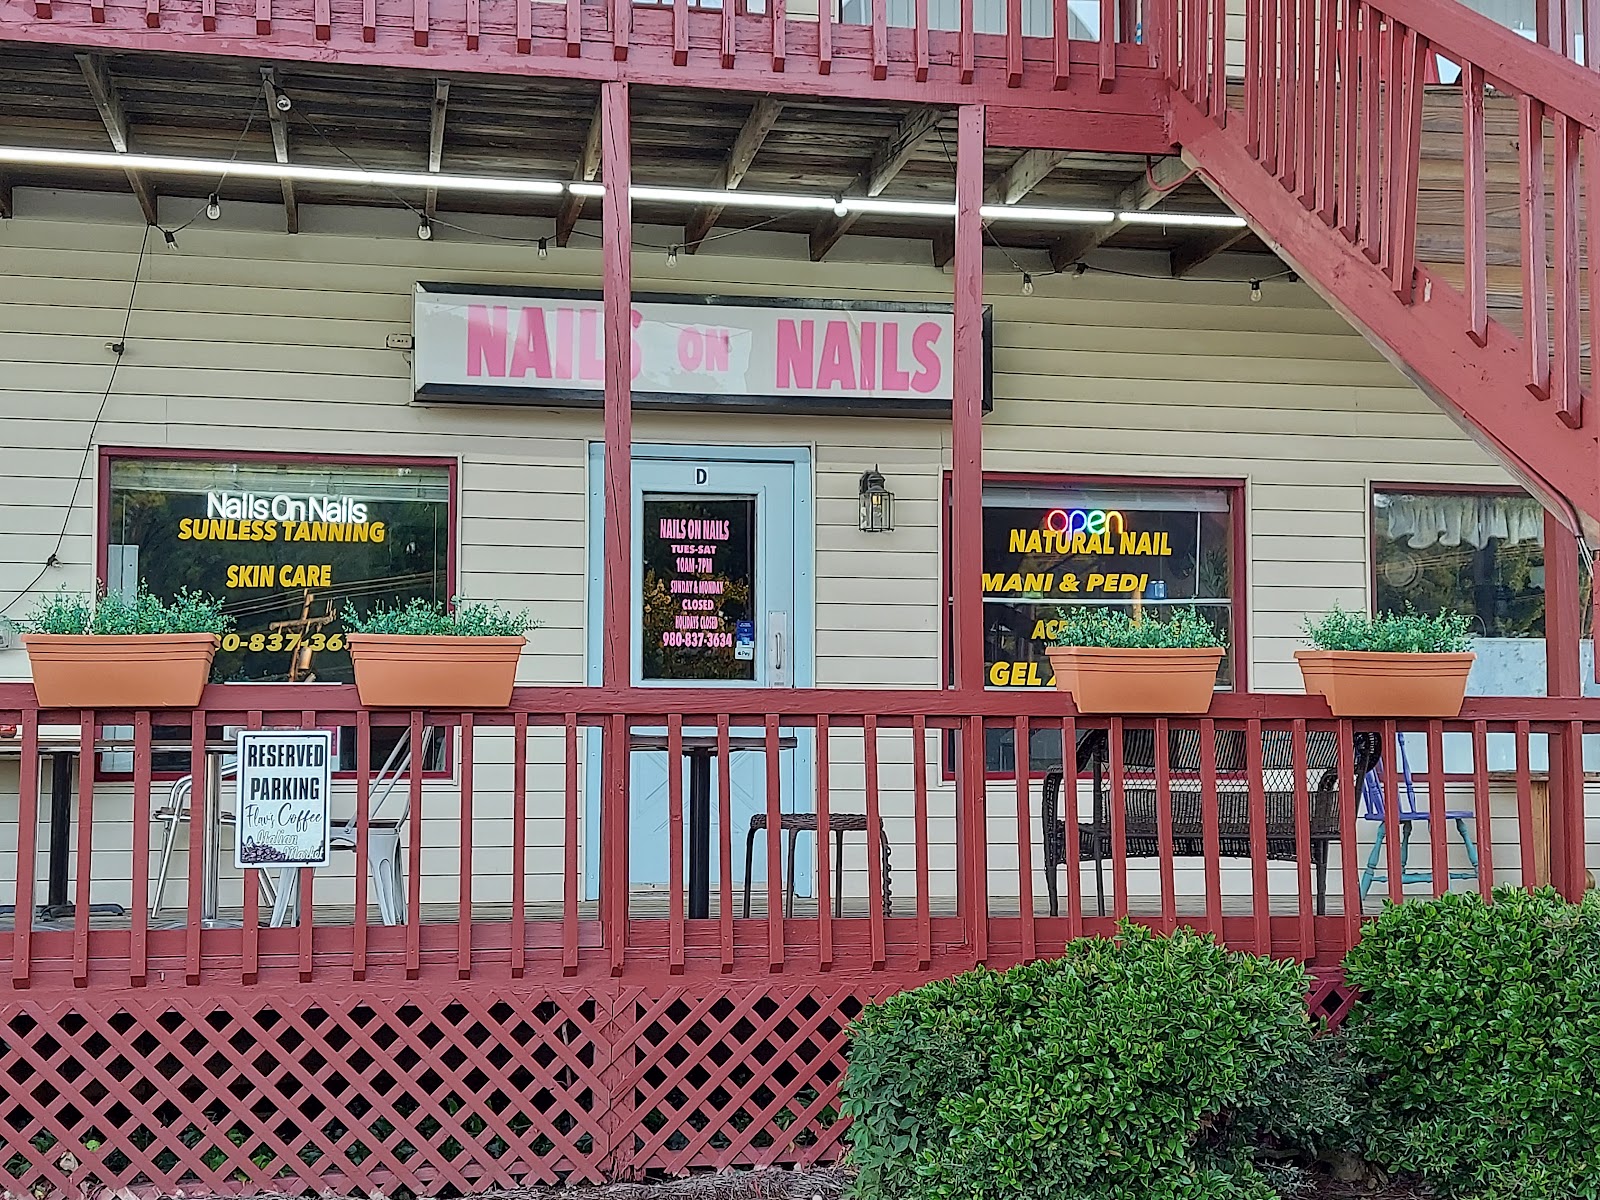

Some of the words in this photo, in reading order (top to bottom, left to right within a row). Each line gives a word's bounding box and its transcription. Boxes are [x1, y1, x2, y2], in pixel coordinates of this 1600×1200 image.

[678, 328, 728, 371] ON
[776, 319, 942, 393] NAILS
[696, 468, 707, 485] D
[207, 492, 269, 519] Nails
[271, 495, 305, 522] On
[309, 496, 368, 523] Nails
[178, 518, 277, 541] SUNLESS
[283, 521, 385, 544] TANNING
[660, 519, 686, 540] NAILS
[687, 519, 701, 540] ON
[703, 520, 729, 540] NAILS
[1048, 510, 1122, 541] open
[671, 544, 717, 554] TUES-SAT
[1009, 529, 1114, 555] NATURAL
[1120, 532, 1172, 556] NAIL
[226, 565, 275, 588] SKIN
[278, 565, 332, 588] CARE
[670, 580, 693, 593] SUNDAY
[693, 581, 699, 593] &
[699, 580, 724, 594] MONDAY
[982, 574, 1054, 592] MANI
[1059, 574, 1080, 592] &
[1086, 574, 1149, 592] PEDI
[682, 599, 714, 611] CLOSED
[675, 615, 699, 629] HOLIDAYS
[700, 616, 718, 629] CLOSED
[662, 632, 733, 647] 980-837-3634
[989, 662, 1042, 686] GEL
[248, 745, 323, 767] RESERVED
[251, 778, 319, 800] PARKING
[278, 802, 322, 832] Coffee
